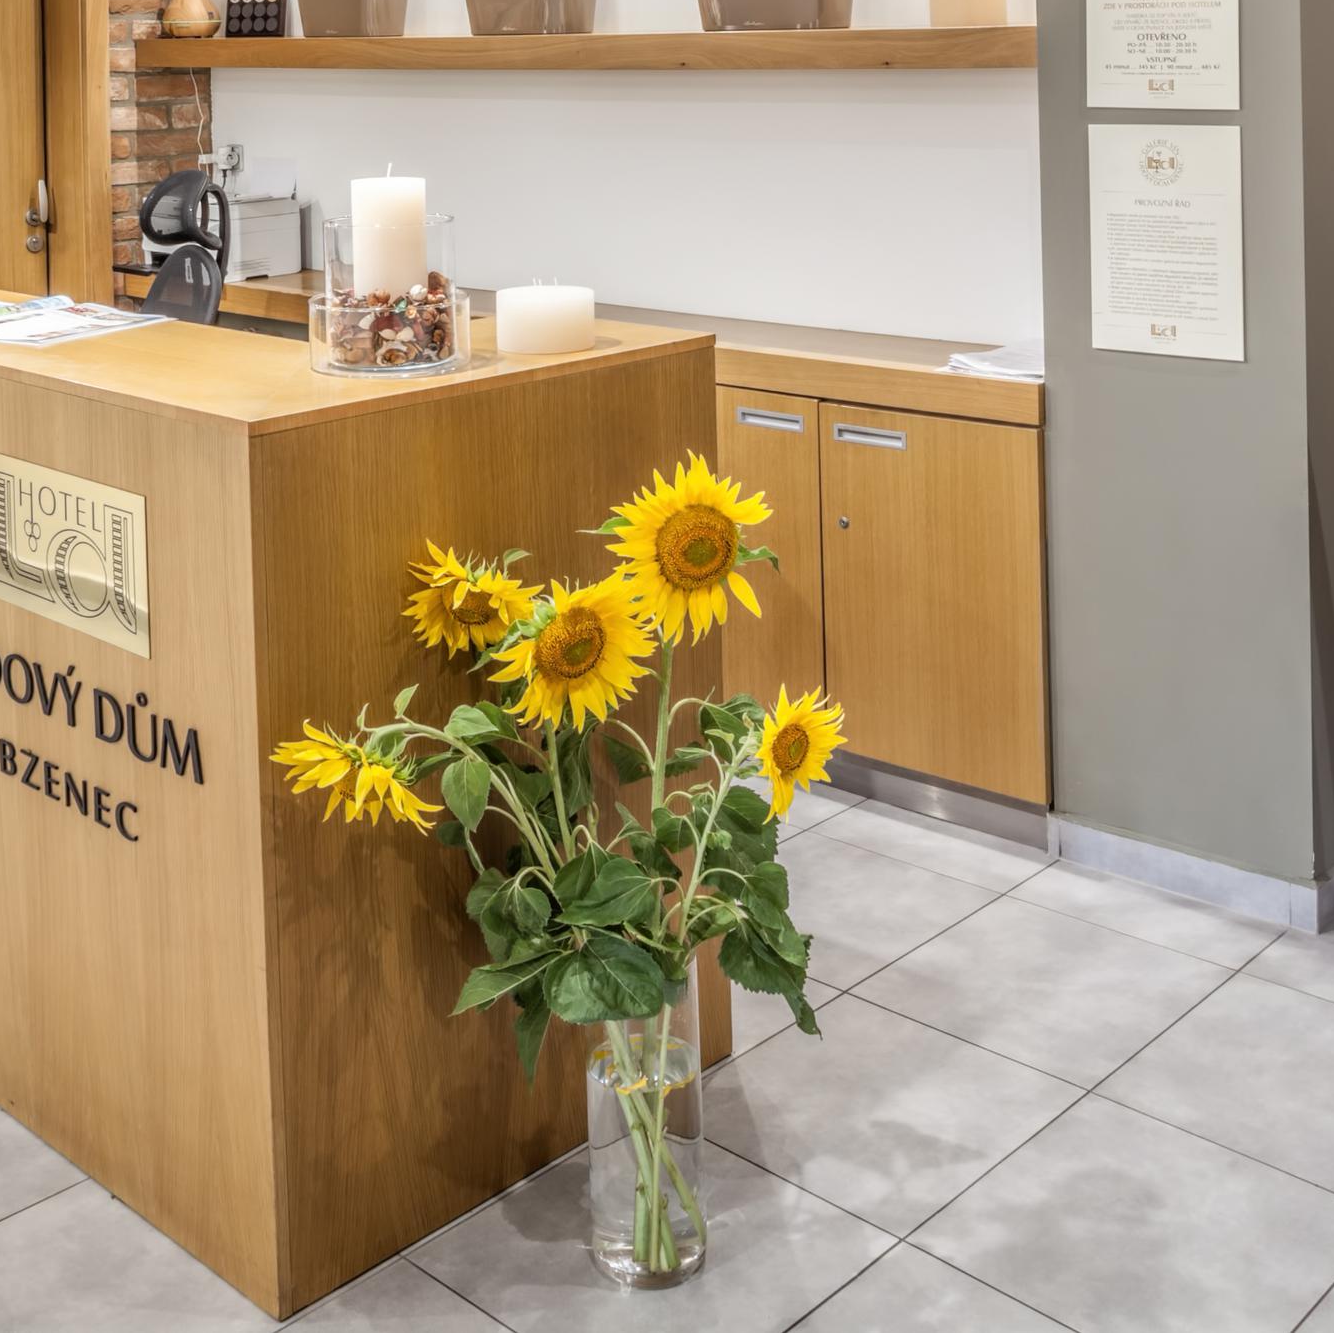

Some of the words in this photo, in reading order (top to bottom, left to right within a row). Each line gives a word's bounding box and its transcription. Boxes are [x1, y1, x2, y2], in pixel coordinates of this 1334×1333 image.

[1137, 33, 1186, 41] OTEVŘENO
[18, 478, 102, 533] HOTEL
[94, 686, 205, 785] DŮM
